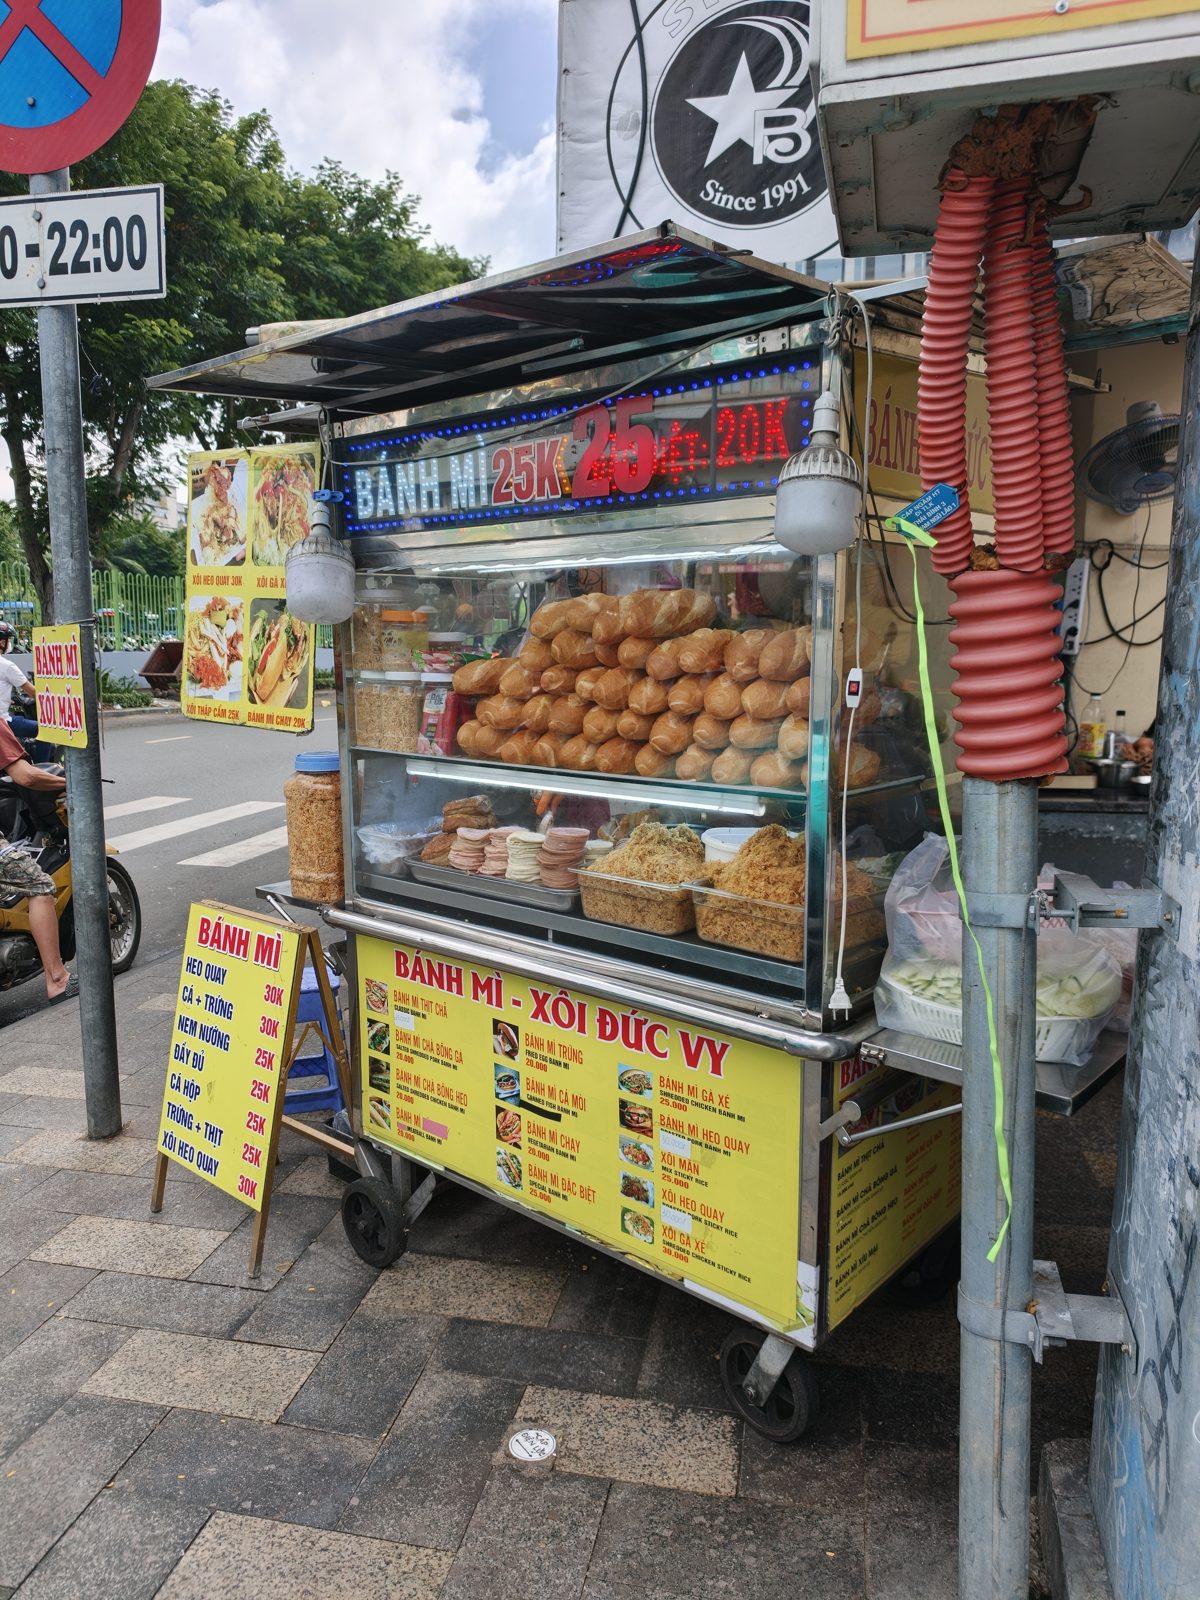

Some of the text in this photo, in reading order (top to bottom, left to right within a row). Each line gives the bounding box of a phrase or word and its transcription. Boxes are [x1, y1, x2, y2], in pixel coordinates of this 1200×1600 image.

[700, 173, 812, 212] Since 1991
[572, 394, 656, 499] 25
[717, 397, 791, 467] 20K
[355, 450, 441, 519] BÁNH
[451, 434, 489, 510] MÌ
[491, 436, 563, 507] 25K
[931, 488, 941, 498] HT
[203, 575, 214, 586] HEO
[215, 575, 230, 586] QUAY
[231, 575, 243, 586] 30K
[35, 634, 80, 677] BÁNH MÌ
[38, 686, 82, 738] XÔI MẶN
[227, 709, 240, 720] 25K
[247, 711, 306, 729] BÁNH MÌ CHAY 20K
[197, 915, 283, 971] BÁNH MÌ
[185, 956, 284, 1006] HEO QUAY 30K
[182, 985, 193, 1005] CÁ
[204, 993, 234, 1020] TRỨNG
[259, 1016, 279, 1039] 30K
[394, 950, 465, 998] BÁNH
[471, 971, 504, 1010] MÌ
[528, 988, 588, 1036] XÔI
[596, 1009, 669, 1060] ĐỨC
[677, 1030, 732, 1079] VY
[177, 1014, 275, 1071] NEM NƯỚNG 25K
[395, 1029, 411, 1046] BÁNH
[524, 1032, 545, 1052] BÁNH
[546, 1038, 556, 1056] MÌ
[396, 1051, 414, 1065] 20.000
[525, 1049, 570, 1070] FRIED EGG BANH MI
[525, 1058, 548, 1073] 20.000
[192, 1049, 205, 1072] ĐỦ
[250, 1079, 271, 1104] 25K
[525, 1077, 545, 1097] BÁNH
[547, 1083, 557, 1101] MÌ
[559, 1088, 569, 1106] CÁ
[659, 1074, 730, 1109] BÁNH MÌ GÀ XÉ
[170, 1072, 267, 1136] CÁ HỘP 25K
[396, 1091, 414, 1105] 20.000
[455, 1090, 468, 1107] HEO
[659, 1097, 688, 1113] 25.000
[659, 1089, 746, 1123] SHREDDED CHICKEN BANH MI
[166, 1101, 194, 1130] TRỨNG
[204, 1121, 224, 1148] THỊT
[242, 1142, 262, 1167] 25K
[397, 1128, 415, 1142] 20.000
[526, 1120, 581, 1154] BÁNH MÌ CHAY
[659, 1113, 684, 1134] BÁNH
[687, 1122, 699, 1138] MÌ
[702, 1128, 720, 1145] HEO
[723, 1136, 751, 1155] QUAY
[704, 1142, 722, 1154] BANH
[722, 1149, 731, 1157] MI
[161, 1131, 258, 1200] XÔI HEO QUAY 30K
[527, 1146, 550, 1162] 20.000
[661, 1151, 676, 1168] XÔI
[528, 1163, 548, 1184] BÁNH
[550, 1171, 559, 1189] MÌ
[579, 1184, 596, 1205] BIỆT
[661, 1165, 709, 1188] MIX STICKY RICE
[661, 1173, 689, 1189] 25.000
[529, 1188, 552, 1204] 25.000
[661, 1187, 676, 1204] XÔI
[679, 1194, 697, 1212] HEO
[700, 1203, 725, 1223] QUAY
[661, 1225, 706, 1254] XÔI GÀ XÉ
[703, 1218, 739, 1239] STICKY RICE
[662, 1246, 689, 1264] 30.000
[662, 1239, 752, 1284] SHREDDED CHICKEN STICKY RICE
